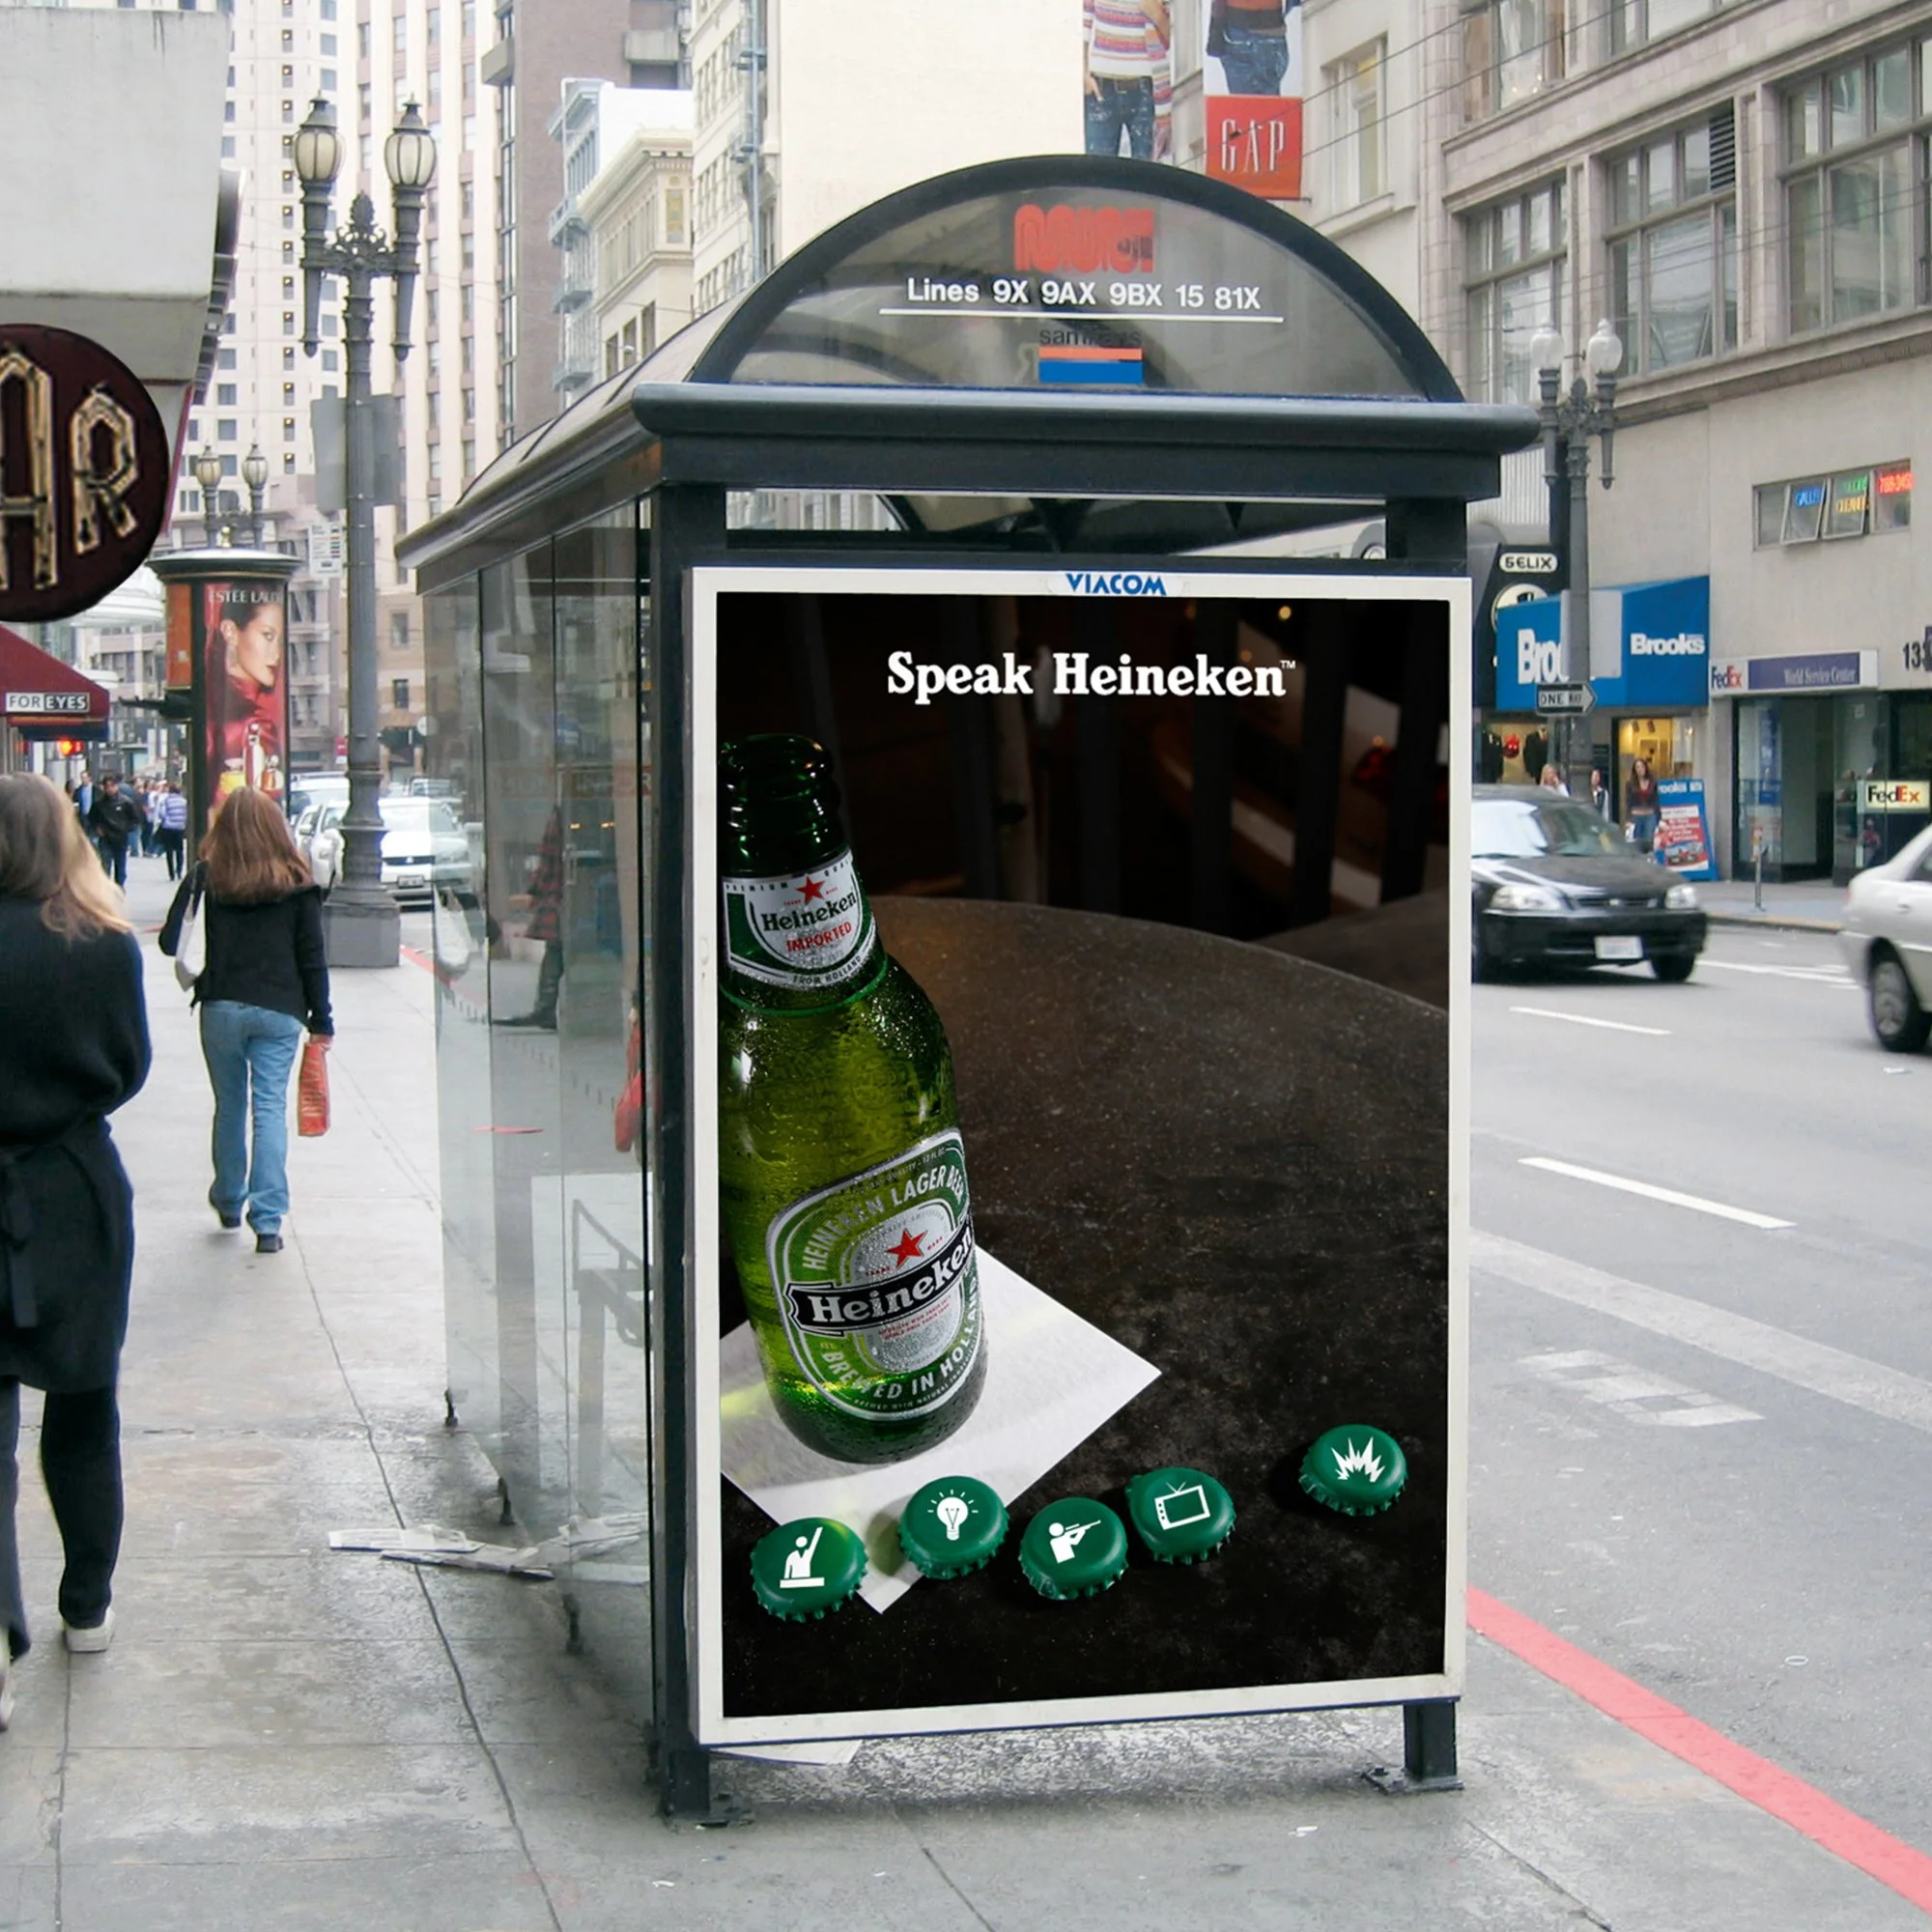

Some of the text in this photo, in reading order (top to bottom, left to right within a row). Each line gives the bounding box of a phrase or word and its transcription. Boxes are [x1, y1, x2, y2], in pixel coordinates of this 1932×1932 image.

[1222, 119, 1284, 173] GAP
[908, 277, 1261, 310] Lines 9X 9AX 9BX 15 81X
[1065, 573, 1167, 595] VIACOM
[1631, 633, 1706, 655] Brooks
[888, 651, 1033, 705] Speak
[1712, 664, 1743, 689] FedEx
[10, 696, 86, 709] FOR EYES
[1541, 693, 1563, 705] ONE
[1867, 784, 1920, 803] FedEx
[761, 891, 857, 931] Heineken
[786, 921, 852, 952] IMPORTED
[825, 954, 862, 982] HOLLAND
[891, 1164, 947, 1208] LAGER
[808, 1226, 973, 1322] Heineken
[821, 1351, 903, 1399] BREWED
[912, 1372, 935, 1395] IN
[940, 1276, 977, 1378] HOLLAND
